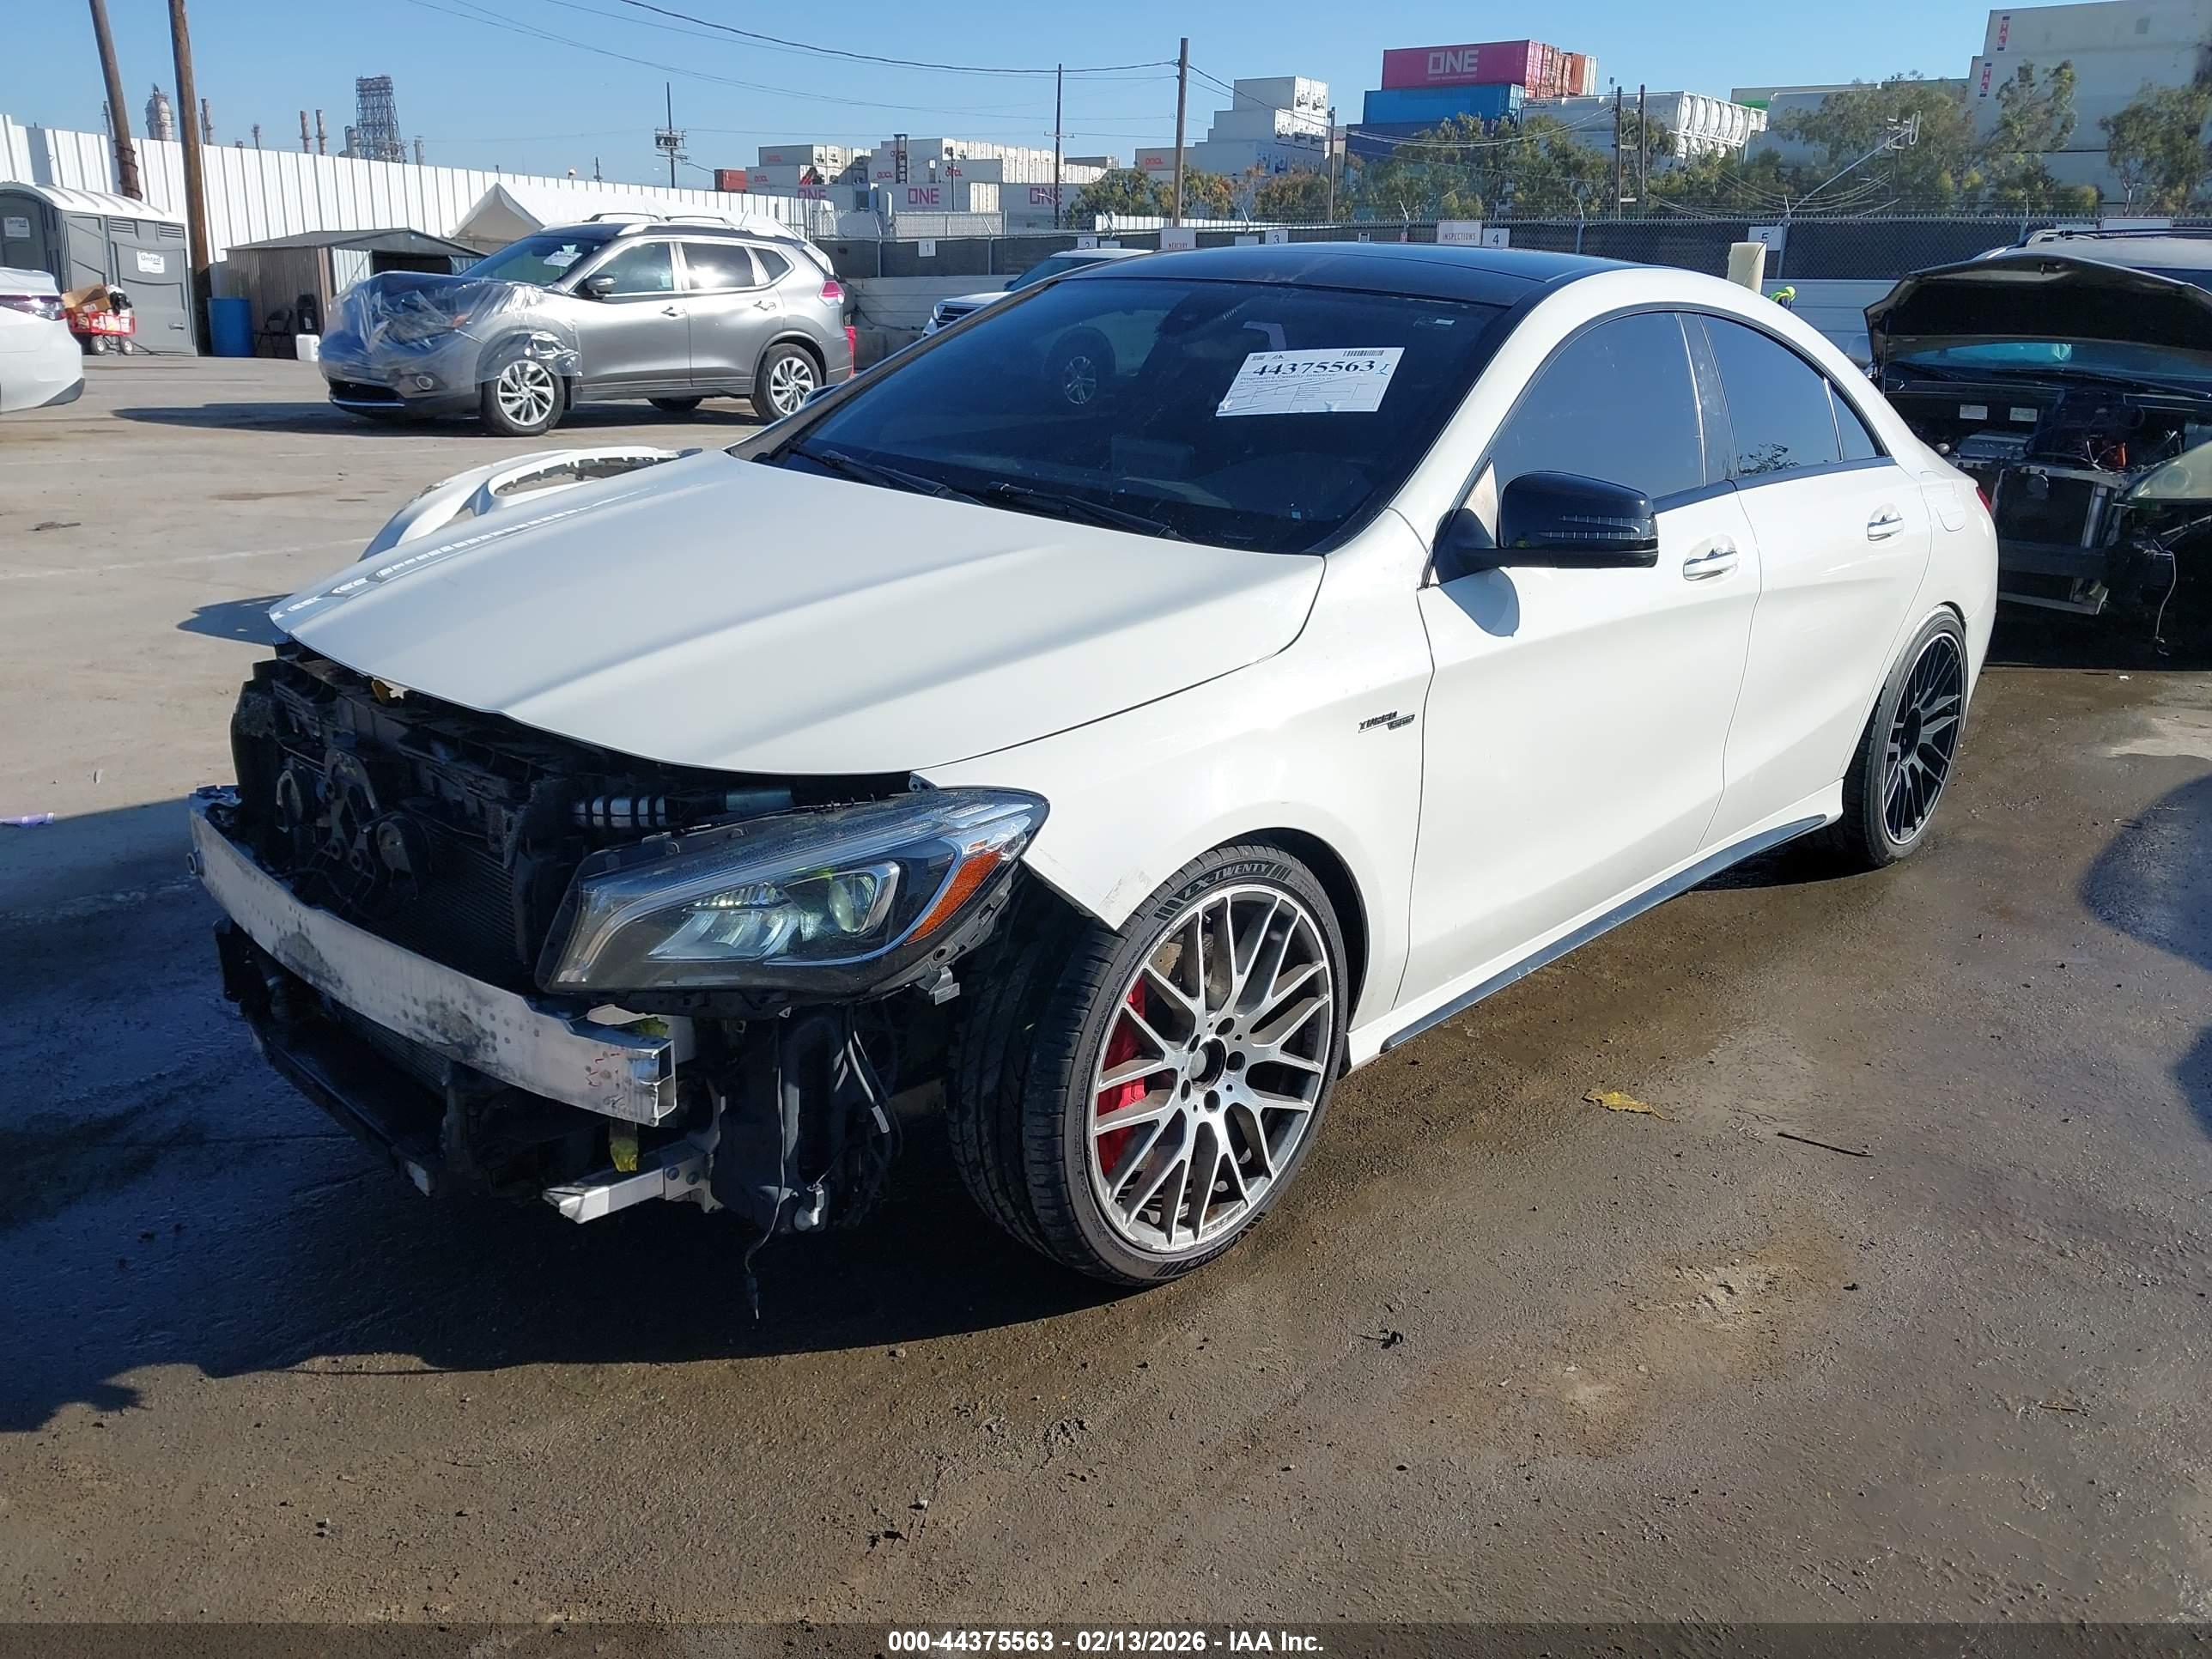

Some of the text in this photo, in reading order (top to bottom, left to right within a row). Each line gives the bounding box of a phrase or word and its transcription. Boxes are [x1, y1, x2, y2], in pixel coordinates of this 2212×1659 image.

[1427, 50, 1479, 75] ONE
[908, 187, 939, 205] ONE
[1273, 234, 1279, 244] 3
[1442, 232, 1477, 241] INSPECTIONS
[1492, 234, 1500, 246] 4
[141, 254, 161, 263] United
[1253, 360, 1376, 376] 44375563
